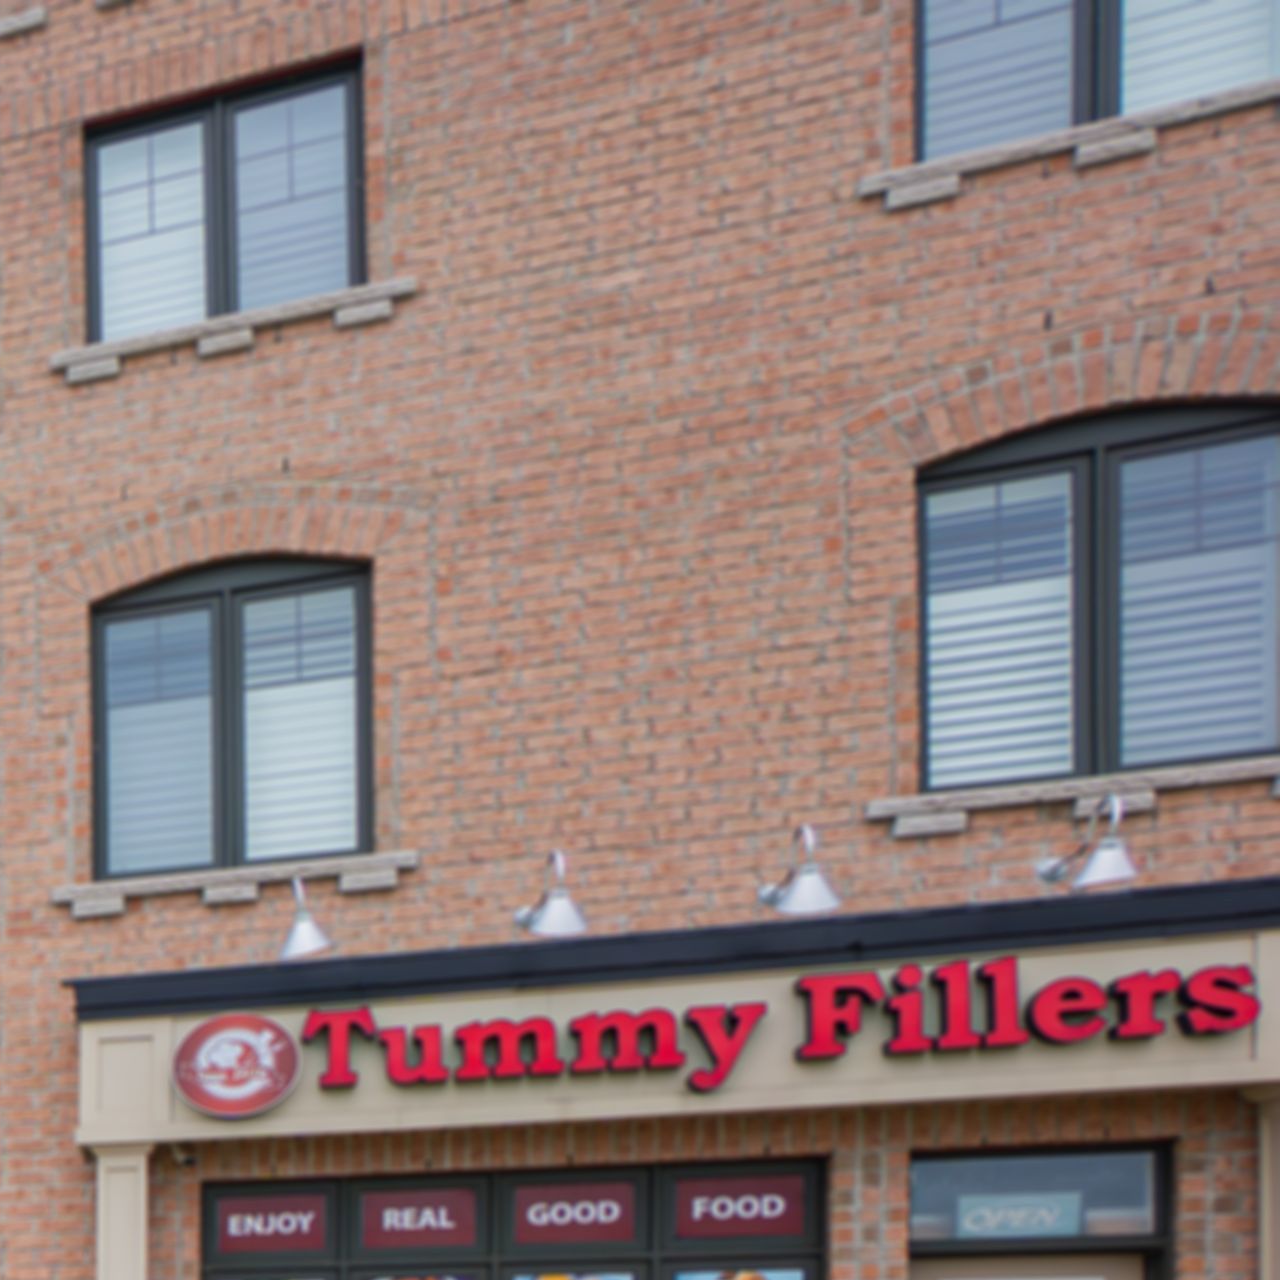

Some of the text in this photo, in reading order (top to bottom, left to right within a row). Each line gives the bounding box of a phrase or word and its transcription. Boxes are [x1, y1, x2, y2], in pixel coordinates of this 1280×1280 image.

[302, 957, 1260, 1091] Tummy Fillers
[383, 1206, 454, 1230] REAL
[526, 1200, 620, 1226] GOOD
[692, 1194, 786, 1220] FOOD
[228, 1211, 314, 1236] ENJOY
